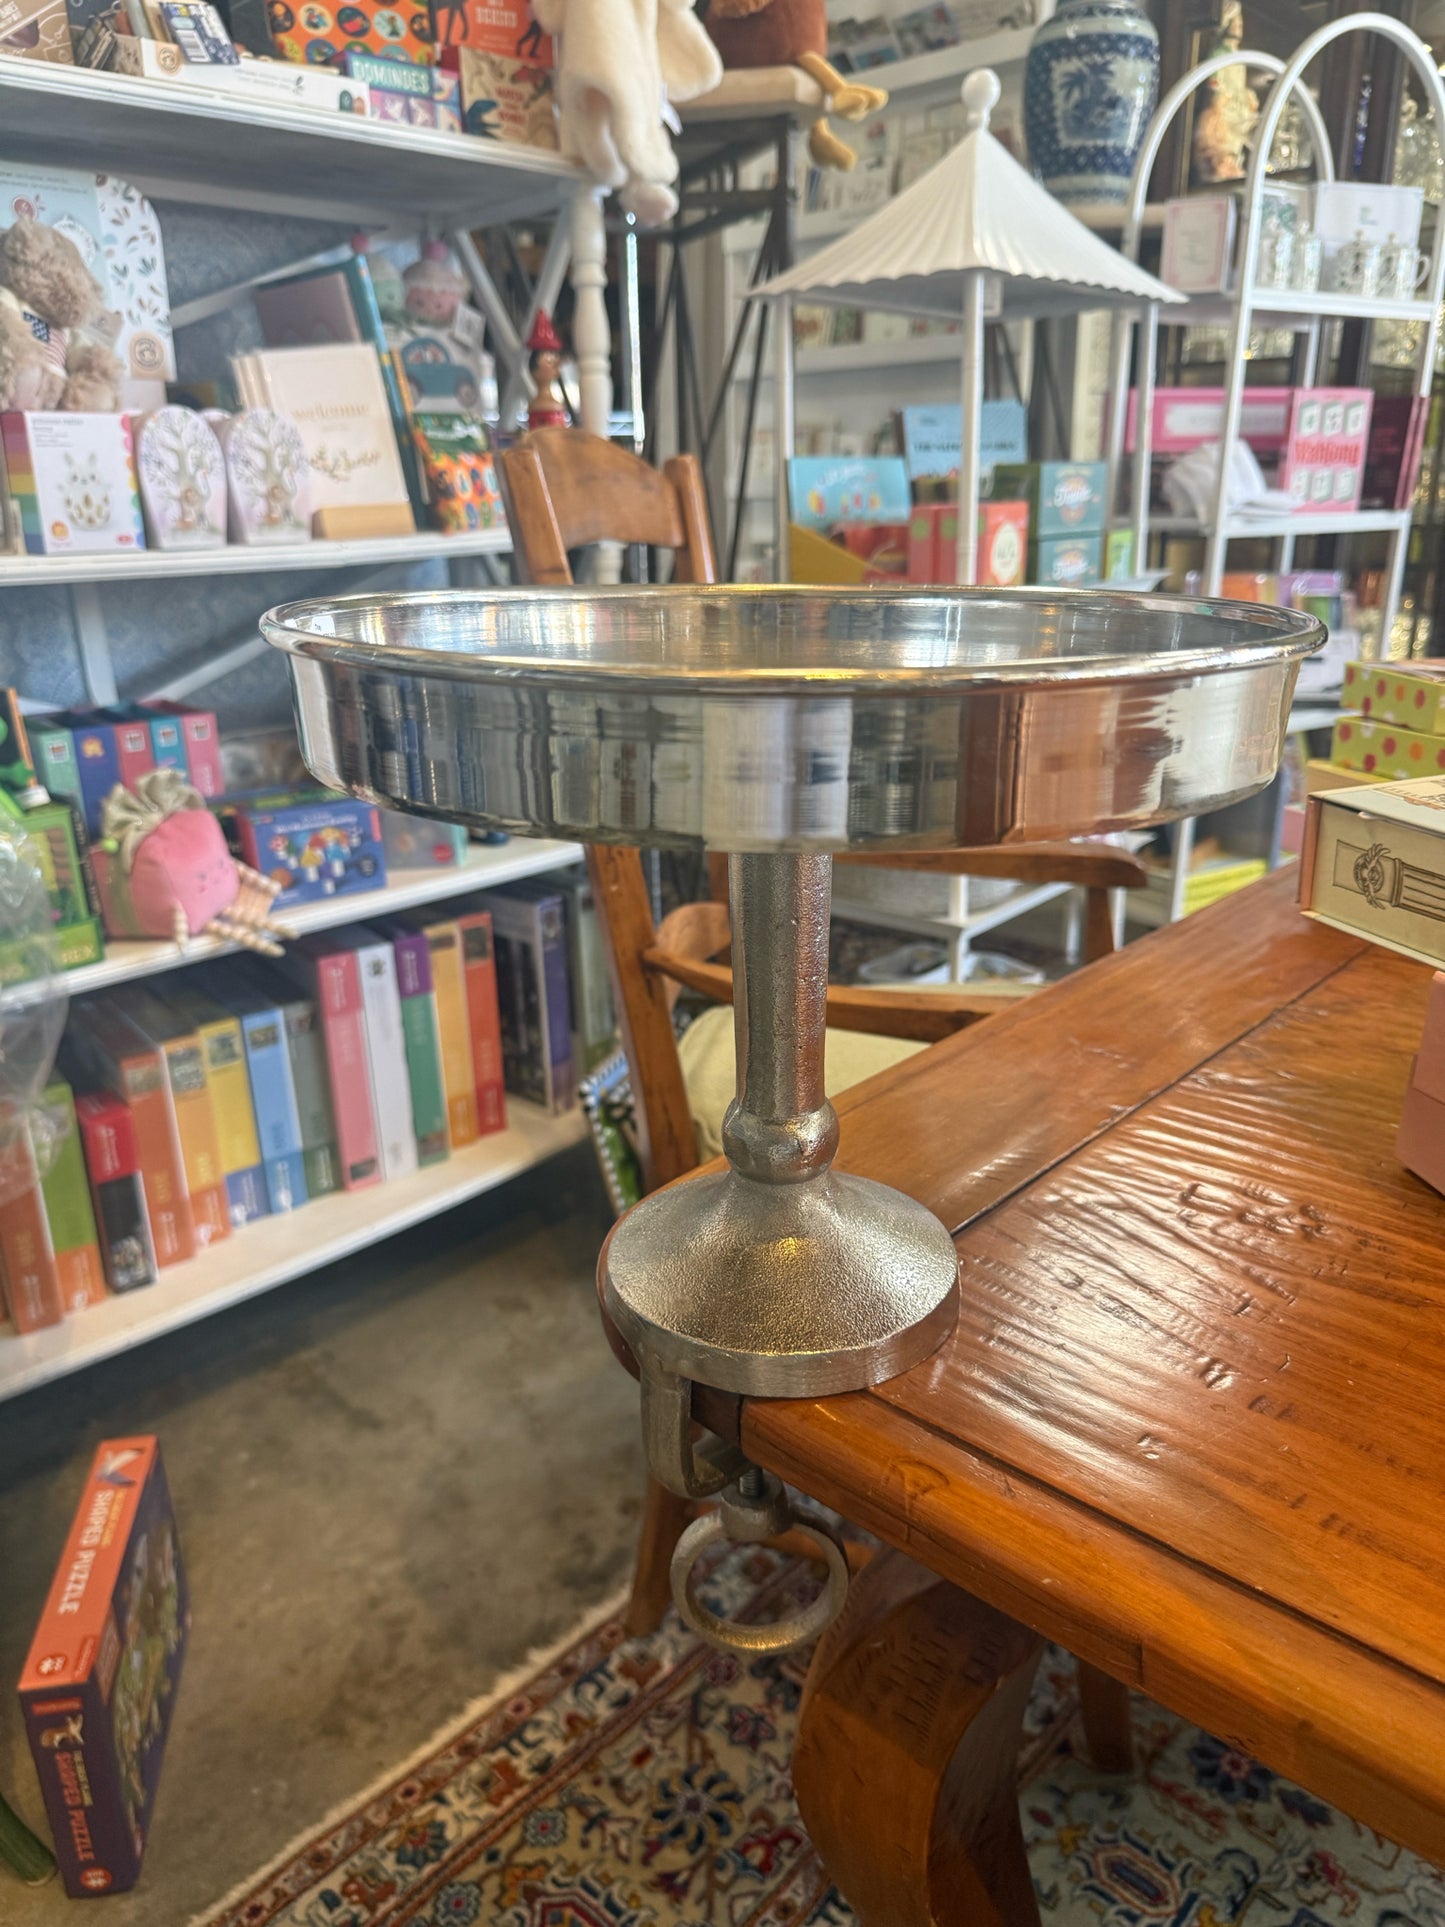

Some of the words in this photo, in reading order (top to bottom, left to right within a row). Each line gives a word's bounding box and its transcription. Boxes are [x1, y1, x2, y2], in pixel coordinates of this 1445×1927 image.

[81, 1489, 115, 1547] SHAPED
[57, 1549, 97, 1614] PUZZLE
[69, 1808, 95, 1862] PUZZLE
